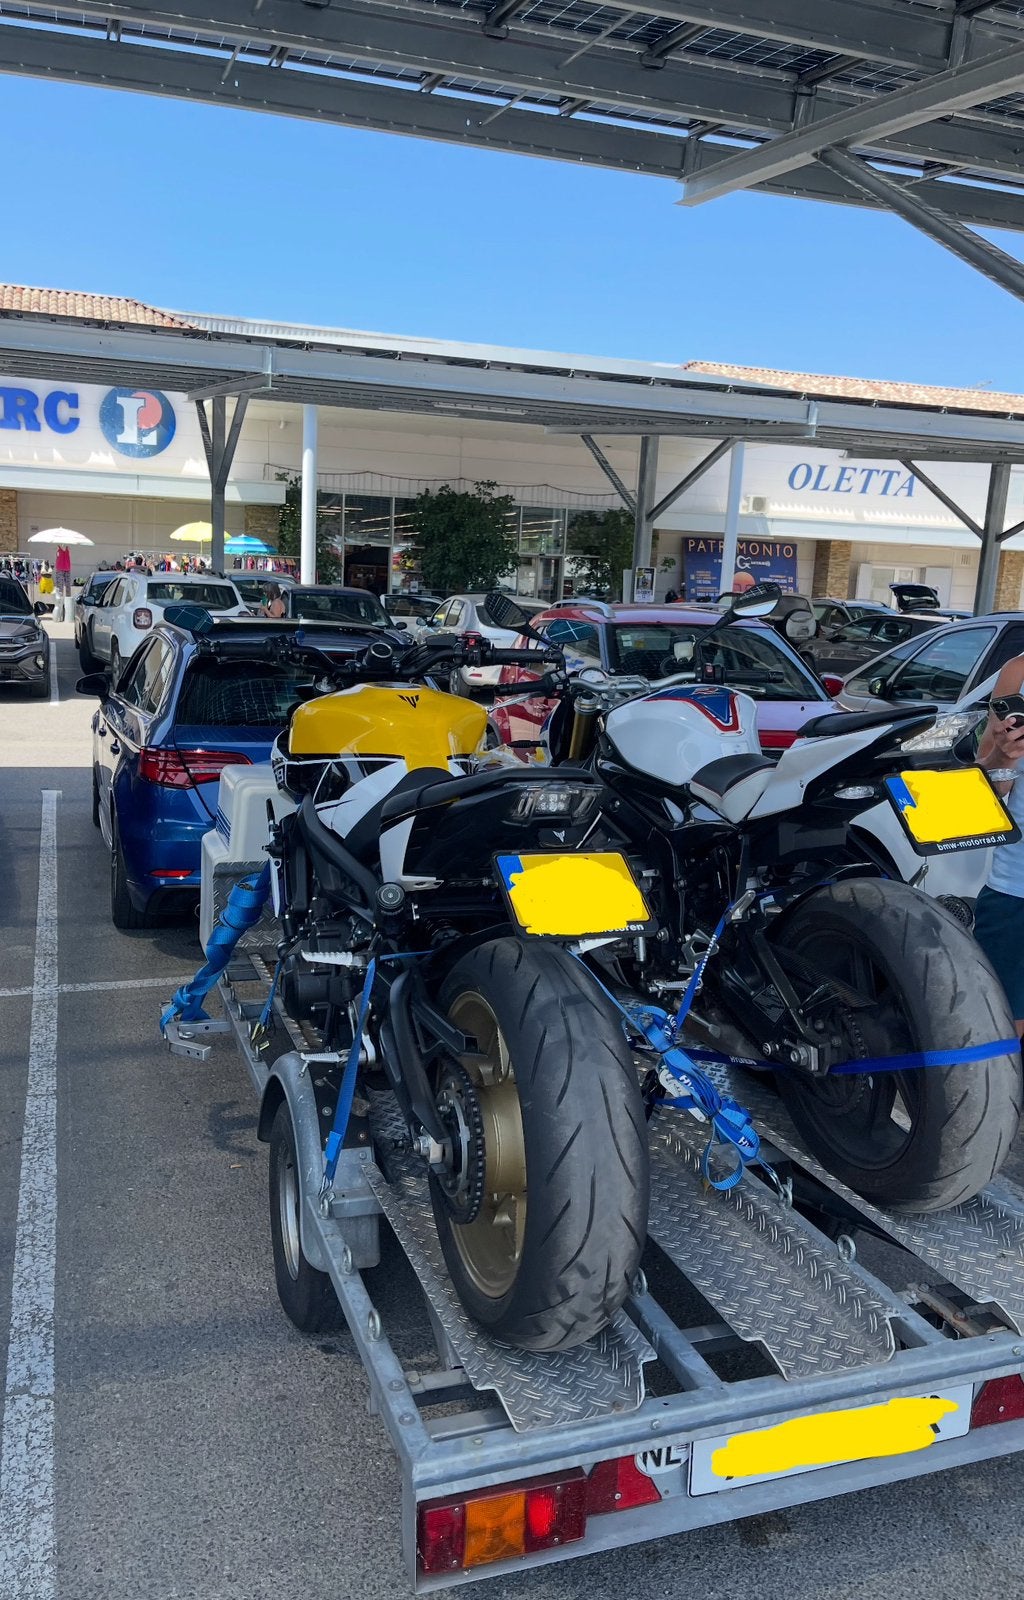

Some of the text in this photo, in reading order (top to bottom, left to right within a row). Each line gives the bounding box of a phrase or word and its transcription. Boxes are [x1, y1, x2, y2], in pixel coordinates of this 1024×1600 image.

[788, 463, 915, 497] OLETTA
[688, 540, 793, 558] PATRMONIO
[937, 834, 1006, 851] bmw-motorrad.nl
[640, 1446, 682, 1468] NL
